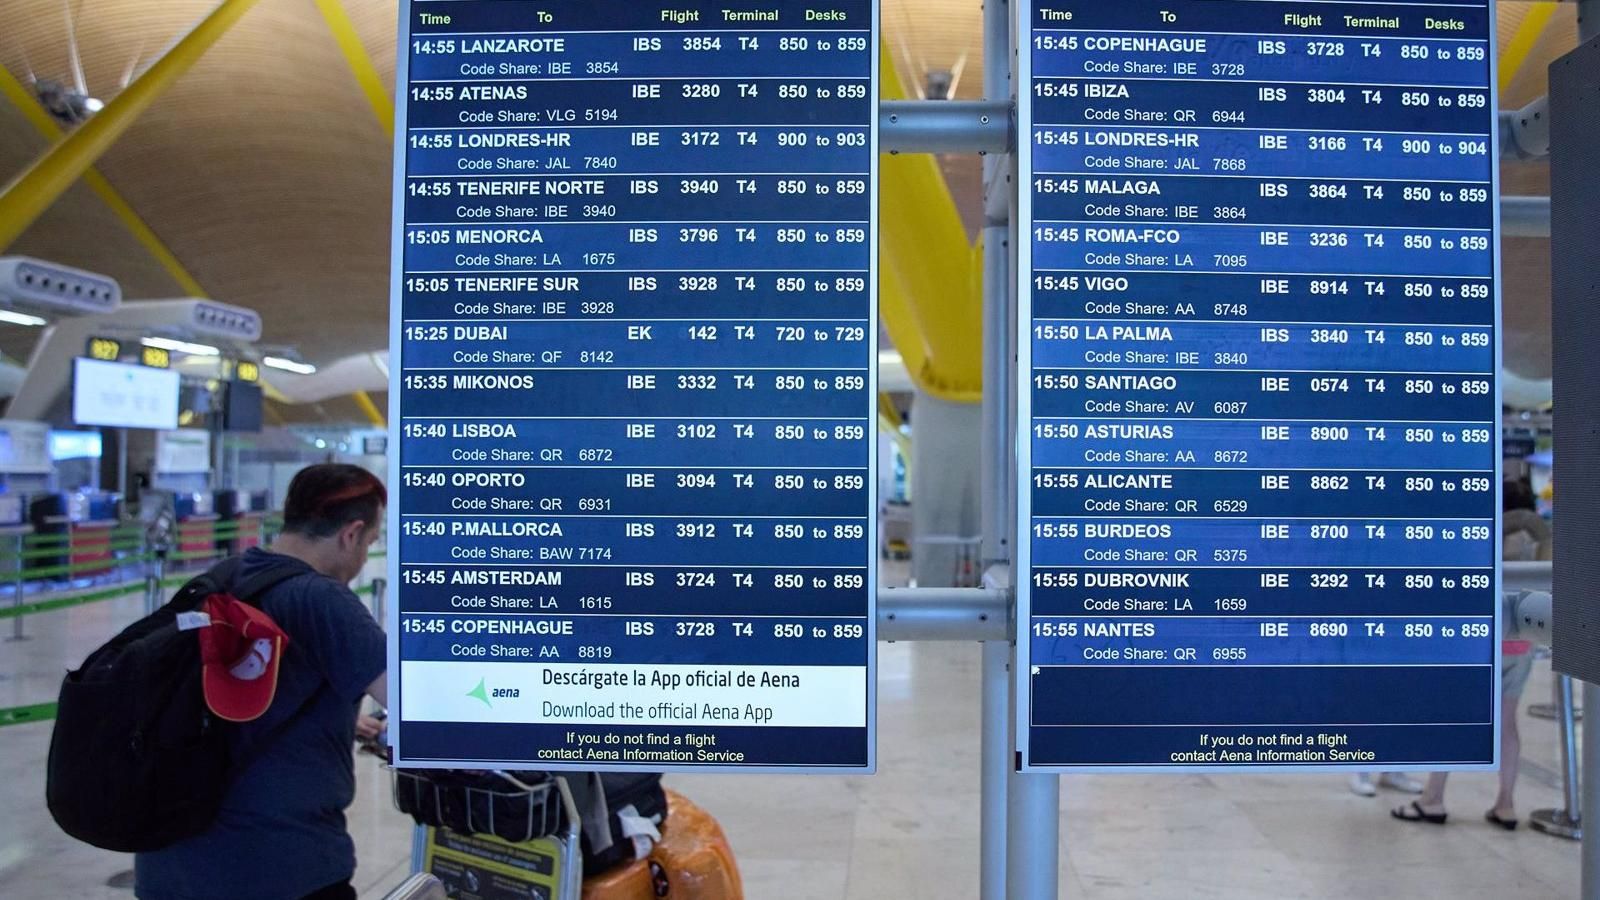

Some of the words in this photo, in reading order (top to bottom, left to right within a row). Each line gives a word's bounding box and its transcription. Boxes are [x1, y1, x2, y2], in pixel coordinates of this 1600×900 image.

[419, 13, 451, 25] Time
[536, 11, 553, 23] To
[661, 9, 699, 24] Flight
[721, 9, 779, 21] Terminal
[805, 9, 847, 21] Desks
[1039, 8, 1073, 21] Time
[1159, 10, 1177, 23] To
[1284, 13, 1322, 29] Flight
[1343, 15, 1400, 29] Terminal
[1425, 17, 1465, 31] Desks
[413, 39, 456, 55] 14:55
[461, 38, 565, 54] LANZAROTE
[633, 37, 662, 51] IBS
[682, 37, 722, 51] 3854
[737, 36, 759, 51] T4
[779, 37, 809, 51] 850
[816, 39, 831, 51] to
[837, 37, 867, 51] 859
[1033, 35, 1079, 51] 15:45
[1083, 36, 1207, 53] COPENHAGUE
[1257, 40, 1286, 55] IBS
[1307, 41, 1345, 57] 3728
[1360, 43, 1382, 57] T4
[1400, 45, 1429, 59] 850
[1437, 48, 1451, 60] to
[1456, 46, 1485, 61] 859
[460, 63, 495, 75] Code
[498, 62, 542, 75] Share:
[547, 62, 572, 75] IBE
[585, 61, 619, 74] 3854
[1083, 60, 1120, 73] Code
[1123, 61, 1167, 74] Share:
[1173, 62, 1197, 75] IBE
[1211, 63, 1245, 76] 3728
[408, 182, 451, 197] 14:55
[456, 181, 541, 196] TENERIFE
[545, 180, 605, 195] NORTE
[630, 180, 659, 194] IBS
[680, 179, 719, 194] 3940
[735, 179, 757, 194] T4
[777, 180, 807, 194] 850
[815, 183, 830, 195] to
[836, 180, 865, 195] 859
[1034, 179, 1079, 194] 15:45
[1085, 179, 1161, 195] MALAGA
[1259, 183, 1289, 197] IBS
[1309, 184, 1348, 199] 3864
[1362, 185, 1384, 200] T4
[1403, 186, 1431, 201] 850
[1439, 190, 1453, 202] to
[1459, 188, 1487, 203] 859
[456, 205, 492, 218] Code
[495, 205, 538, 218] Share:
[544, 205, 569, 218] IBE
[582, 204, 616, 217] 3940
[1084, 203, 1121, 217] Code
[1124, 204, 1168, 217] Share:
[1175, 205, 1199, 218] IBE
[1213, 206, 1247, 219] 3864
[405, 326, 449, 341] 15:25
[453, 326, 507, 341] DUBAI
[627, 325, 652, 340] EK
[688, 325, 717, 340] 142
[733, 325, 755, 340] T4
[775, 326, 805, 341] 720
[813, 329, 829, 341] to
[835, 326, 865, 341] 729
[453, 350, 489, 363] Code
[492, 350, 535, 363] Share:
[541, 350, 563, 364] QF
[580, 350, 614, 363] 8142
[404, 375, 447, 389] 15:35
[453, 375, 534, 389] MIKONOS
[627, 375, 656, 389] IBE
[677, 375, 717, 390] 3332
[733, 375, 755, 390] T4
[775, 375, 805, 390] 850
[813, 378, 829, 390] to
[834, 375, 864, 391] 859
[1034, 374, 1079, 390] 15:50
[1084, 375, 1177, 391] SANTIAGO
[1261, 377, 1290, 392] IBE
[1310, 377, 1349, 393] 0574
[1364, 378, 1386, 393] T4
[1405, 379, 1434, 394] 850
[1441, 382, 1456, 394] to
[1461, 380, 1490, 395] 859
[1084, 399, 1121, 413] Code
[1125, 400, 1169, 413] Share:
[1174, 401, 1195, 414] AV
[1214, 401, 1248, 414] 6087
[402, 521, 446, 536] 15:40
[451, 521, 563, 537] P.MALLORCA
[625, 523, 655, 537] IBS
[676, 523, 715, 538] 3912
[732, 523, 754, 538] T4
[774, 524, 804, 539] 850
[812, 527, 827, 539] to
[833, 524, 864, 539] 859
[1033, 523, 1079, 538] 15:55
[1084, 523, 1172, 539] BURDEOS
[1261, 524, 1290, 539] IBE
[1310, 525, 1349, 539] 8700
[1364, 525, 1386, 539] T4
[1405, 525, 1434, 540] 850
[1441, 528, 1456, 540] to
[1461, 525, 1490, 540] 859
[451, 545, 487, 559] Code
[490, 546, 533, 559] Share:
[539, 547, 574, 560] BAW
[578, 547, 612, 560] 7174
[1083, 548, 1121, 561] Code
[1124, 548, 1169, 561] Share:
[1174, 549, 1198, 562] QR
[1213, 549, 1247, 562] 5375
[542, 668, 629, 690] Descárgate
[633, 669, 646, 687] la
[650, 669, 681, 691] App
[685, 669, 732, 687] oficial
[736, 670, 756, 688] de
[760, 671, 800, 688] Aena
[491, 688, 520, 698] aena
[542, 700, 615, 719] Download
[618, 701, 644, 719] the
[648, 702, 697, 720] official
[701, 703, 739, 720] Aena
[743, 703, 773, 725] App
[567, 731, 575, 743] If
[577, 734, 601, 746] you
[604, 732, 620, 744] do
[623, 733, 644, 745] not
[646, 733, 670, 745] find
[673, 735, 682, 745] a
[685, 733, 716, 748] flight
[1200, 734, 1209, 746] If
[1211, 736, 1234, 749] you
[1237, 734, 1254, 746] do
[1257, 734, 1277, 746] not
[1279, 733, 1303, 745] find
[1305, 736, 1314, 745] a
[1317, 733, 1348, 748] flight
[537, 748, 583, 759] contact
[586, 747, 619, 760] Aena
[623, 748, 693, 761] Information
[697, 749, 745, 762] Service
[1170, 750, 1217, 762] contact
[1219, 749, 1253, 761] Aena
[1256, 749, 1325, 761] Information
[1329, 749, 1375, 761] Service
